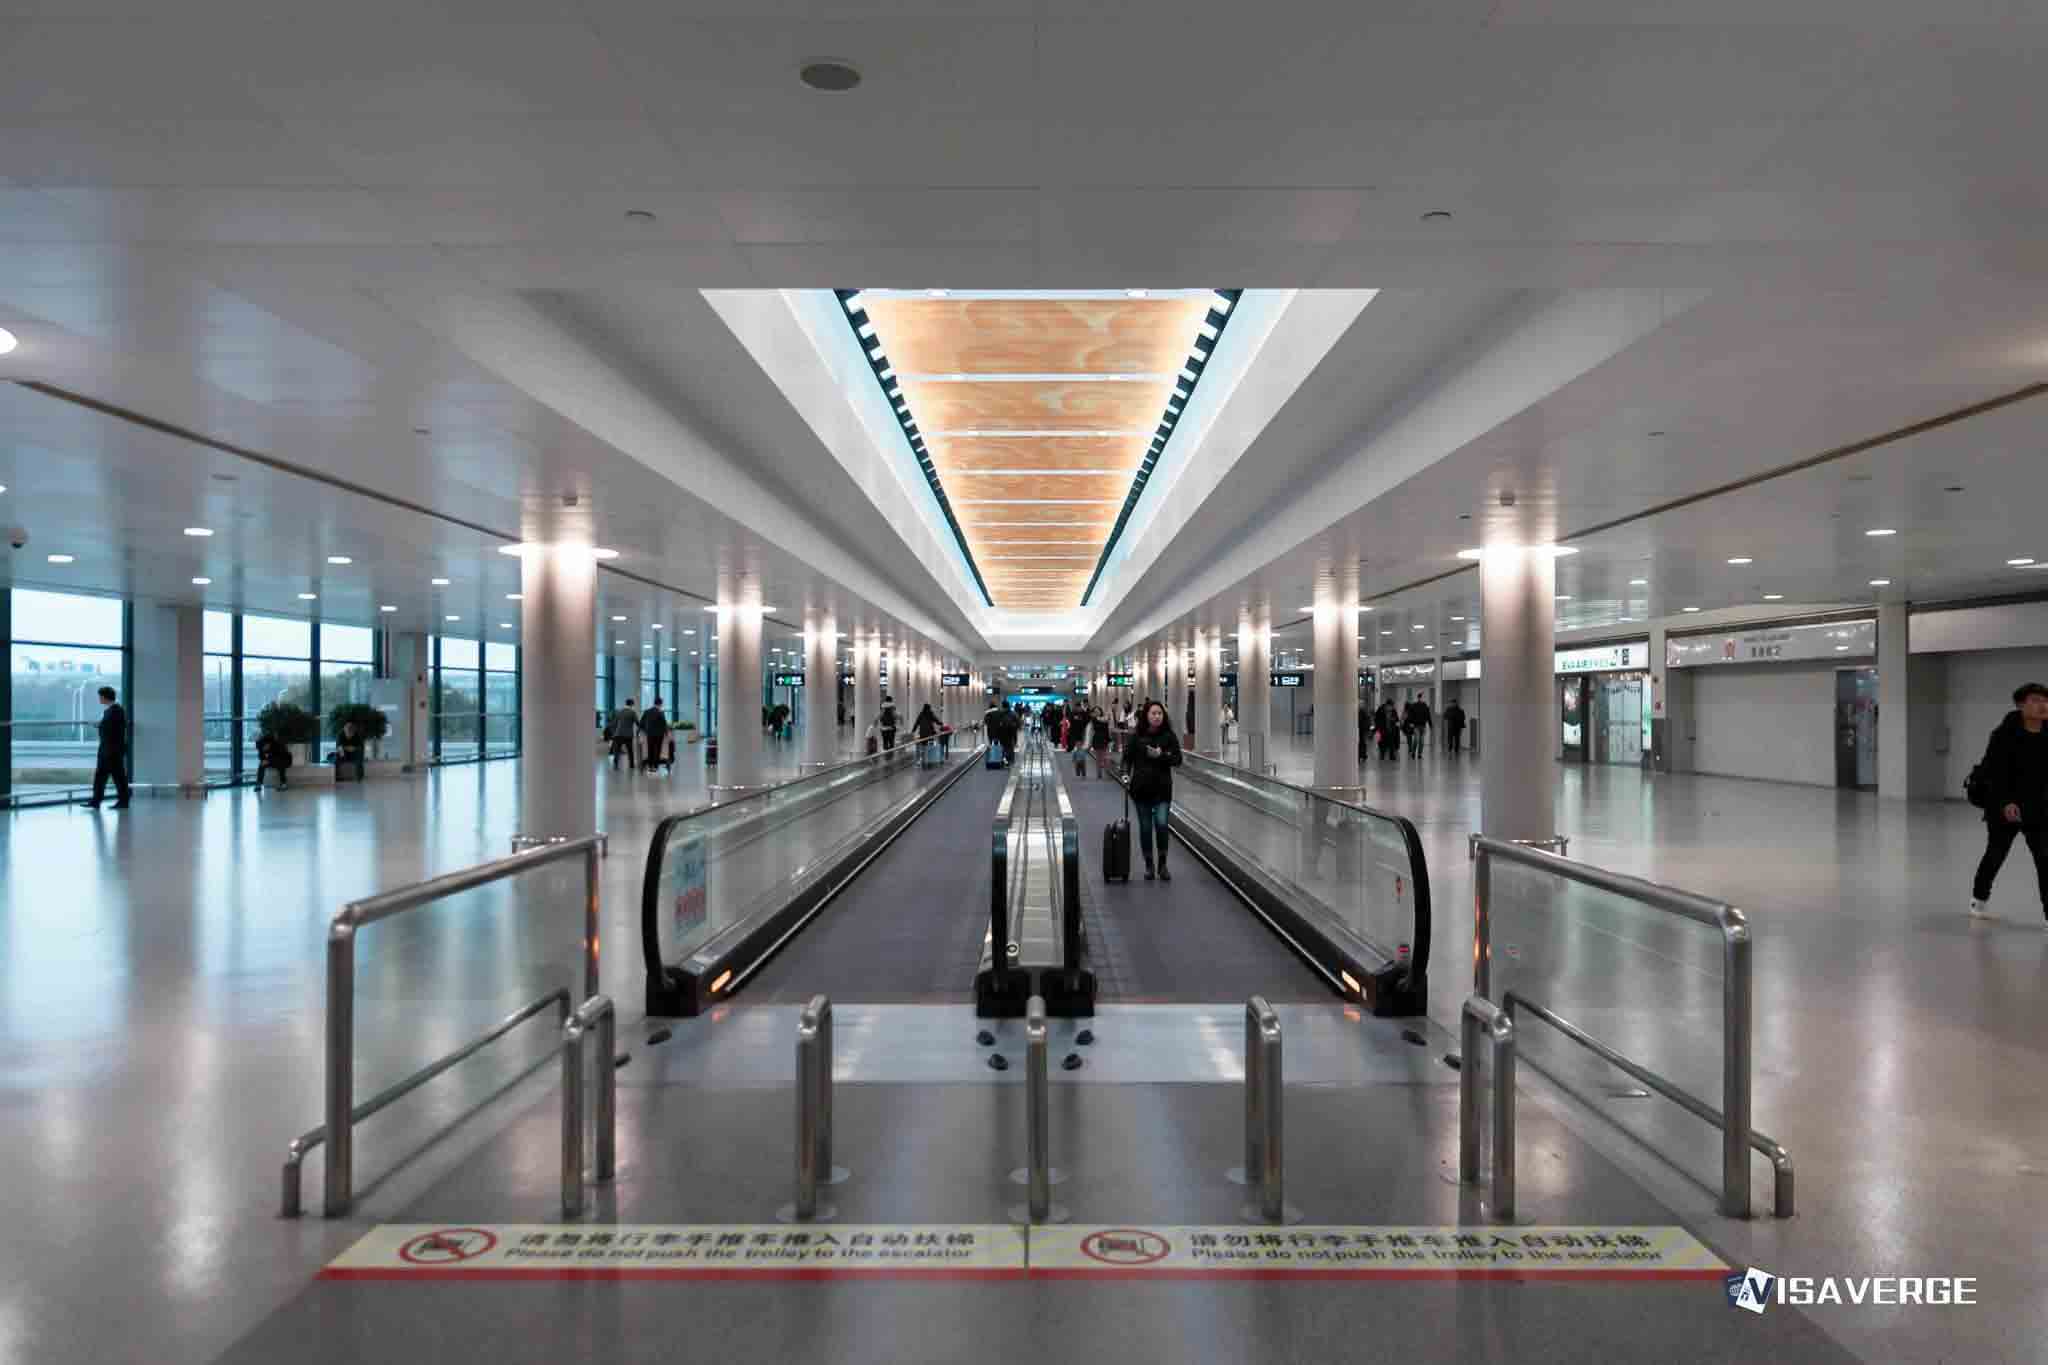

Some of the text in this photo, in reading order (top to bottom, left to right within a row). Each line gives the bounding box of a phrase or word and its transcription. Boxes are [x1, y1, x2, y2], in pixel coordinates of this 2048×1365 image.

[505, 1248, 973, 1261] Please do not push the trolley to the escalator
[1192, 1248, 1663, 1262] Please do not push the trolley to the escalator
